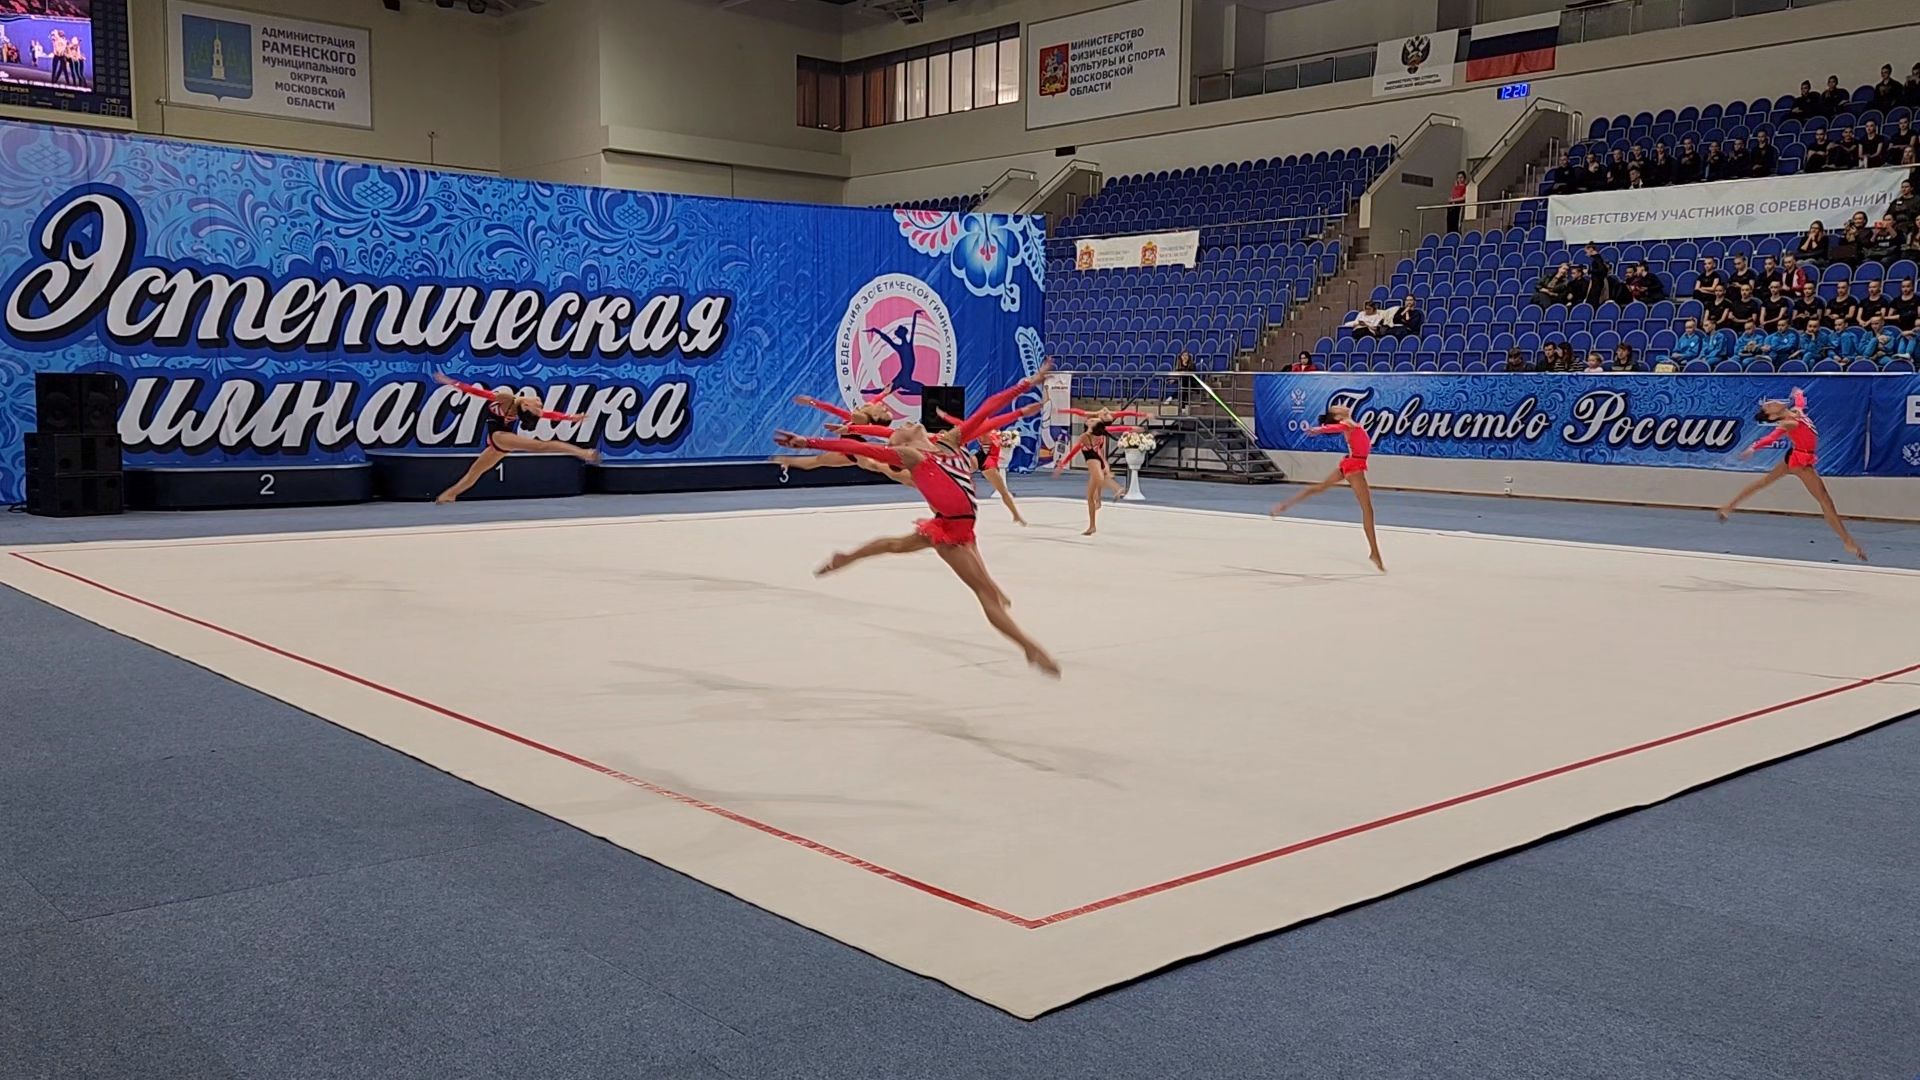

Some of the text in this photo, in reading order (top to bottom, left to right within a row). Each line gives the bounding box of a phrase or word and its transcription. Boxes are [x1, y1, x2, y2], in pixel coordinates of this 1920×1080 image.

[262, 27, 355, 49] АДМИНИСТРАЦИЯ
[1071, 28, 1144, 50] МИНИСТЕРСТВО
[262, 40, 356, 64] РАМЕНСКОГО
[1071, 40, 1133, 61] ФИЗИЧЕСКОЙ
[1071, 48, 1165, 73] КУЛЬТУРЫ И СПОРТА
[290, 72, 328, 85] ОКРУГА
[1071, 64, 1133, 84] МОСКОВСКОЙ
[275, 82, 345, 99] МОСКОВСКОЙ
[1070, 82, 1111, 96] ОБЛАСТИ
[287, 96, 335, 111] ОБЛАСТИ
[1555, 210, 1657, 227] ПРИВЕТСТВУЕМ
[1661, 203, 1754, 221] УЧАСТНИКОВ
[6, 193, 725, 352] Эстетическая
[841, 302, 863, 376] ФЕДЕРАЦИЯ
[928, 299, 952, 374] ГИМНАСТИКИ
[116, 376, 688, 447] имнастика
[1563, 391, 1735, 448] России
[496, 463, 504, 482] 1
[779, 464, 790, 483] 3
[259, 474, 275, 495] 2
